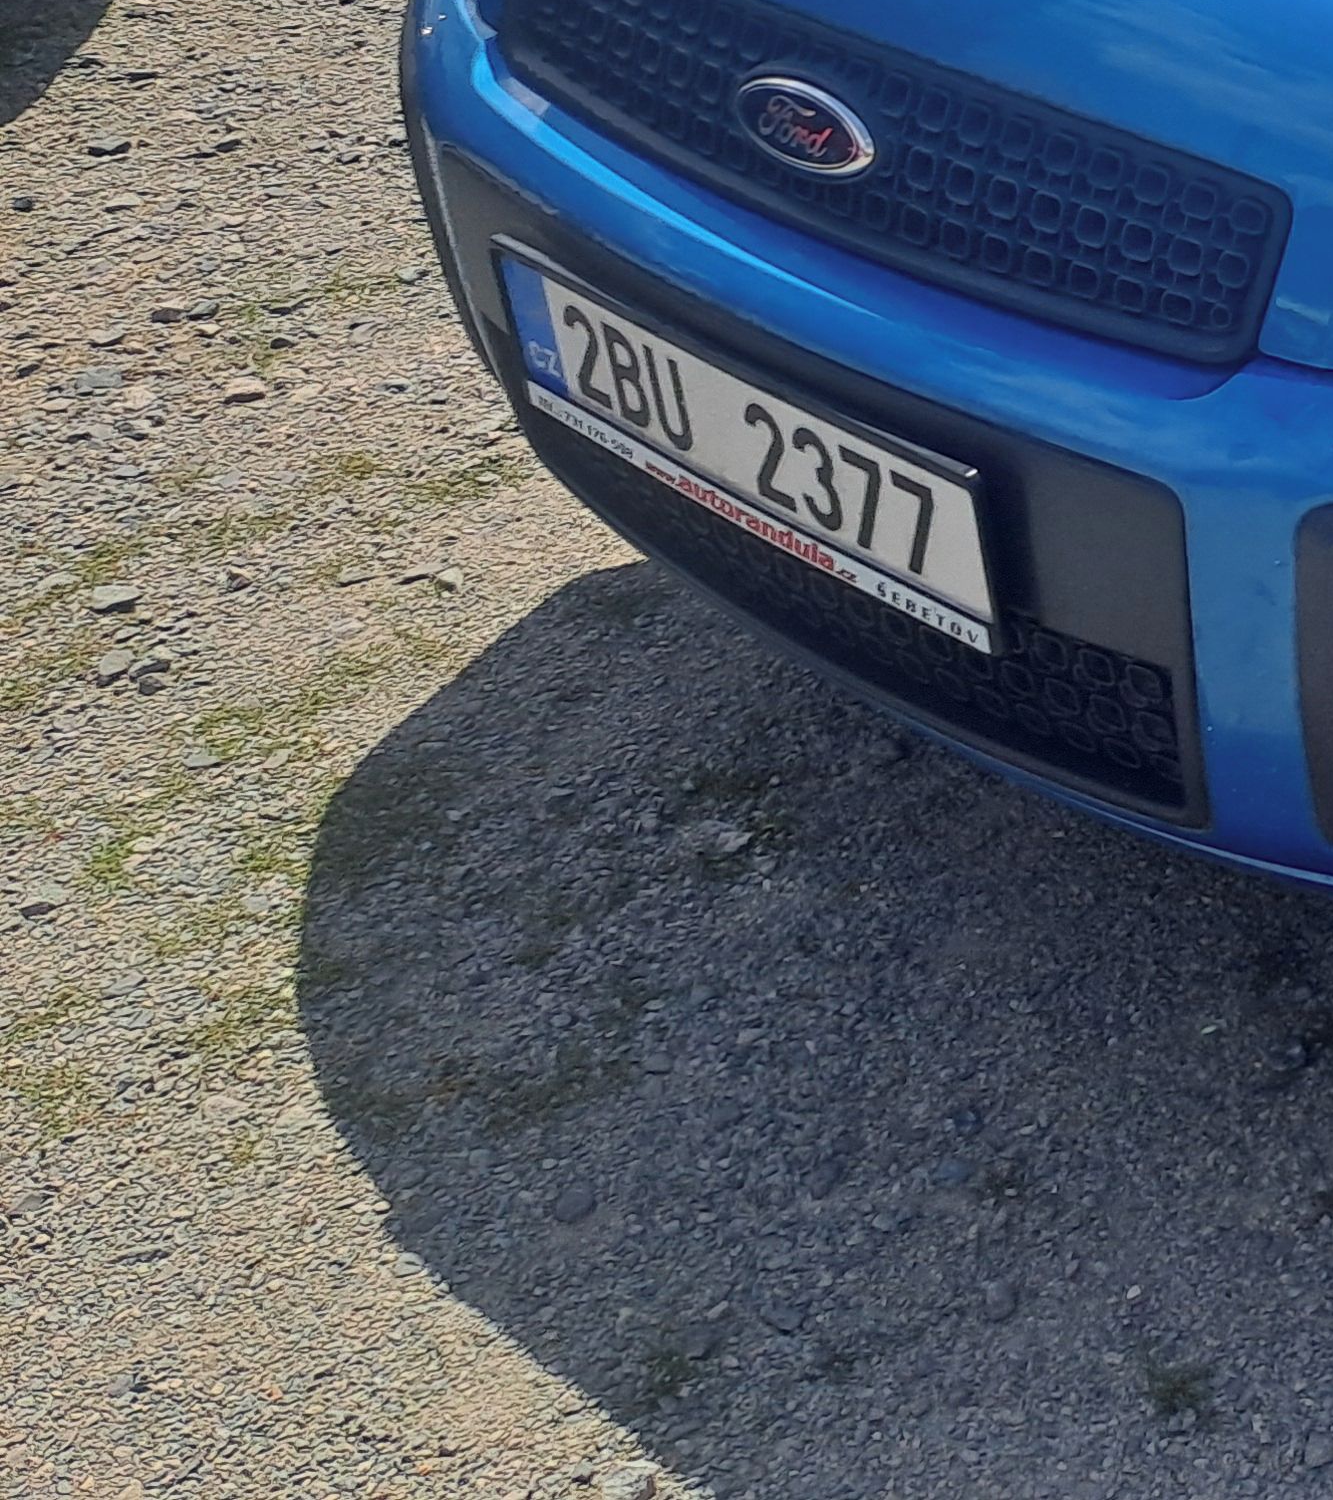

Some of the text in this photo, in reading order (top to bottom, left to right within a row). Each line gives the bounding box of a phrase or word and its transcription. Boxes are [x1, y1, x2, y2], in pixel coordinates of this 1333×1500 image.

[758, 94, 834, 157] Ford
[528, 341, 563, 378] CZ
[563, 304, 933, 576] 2BU 2377
